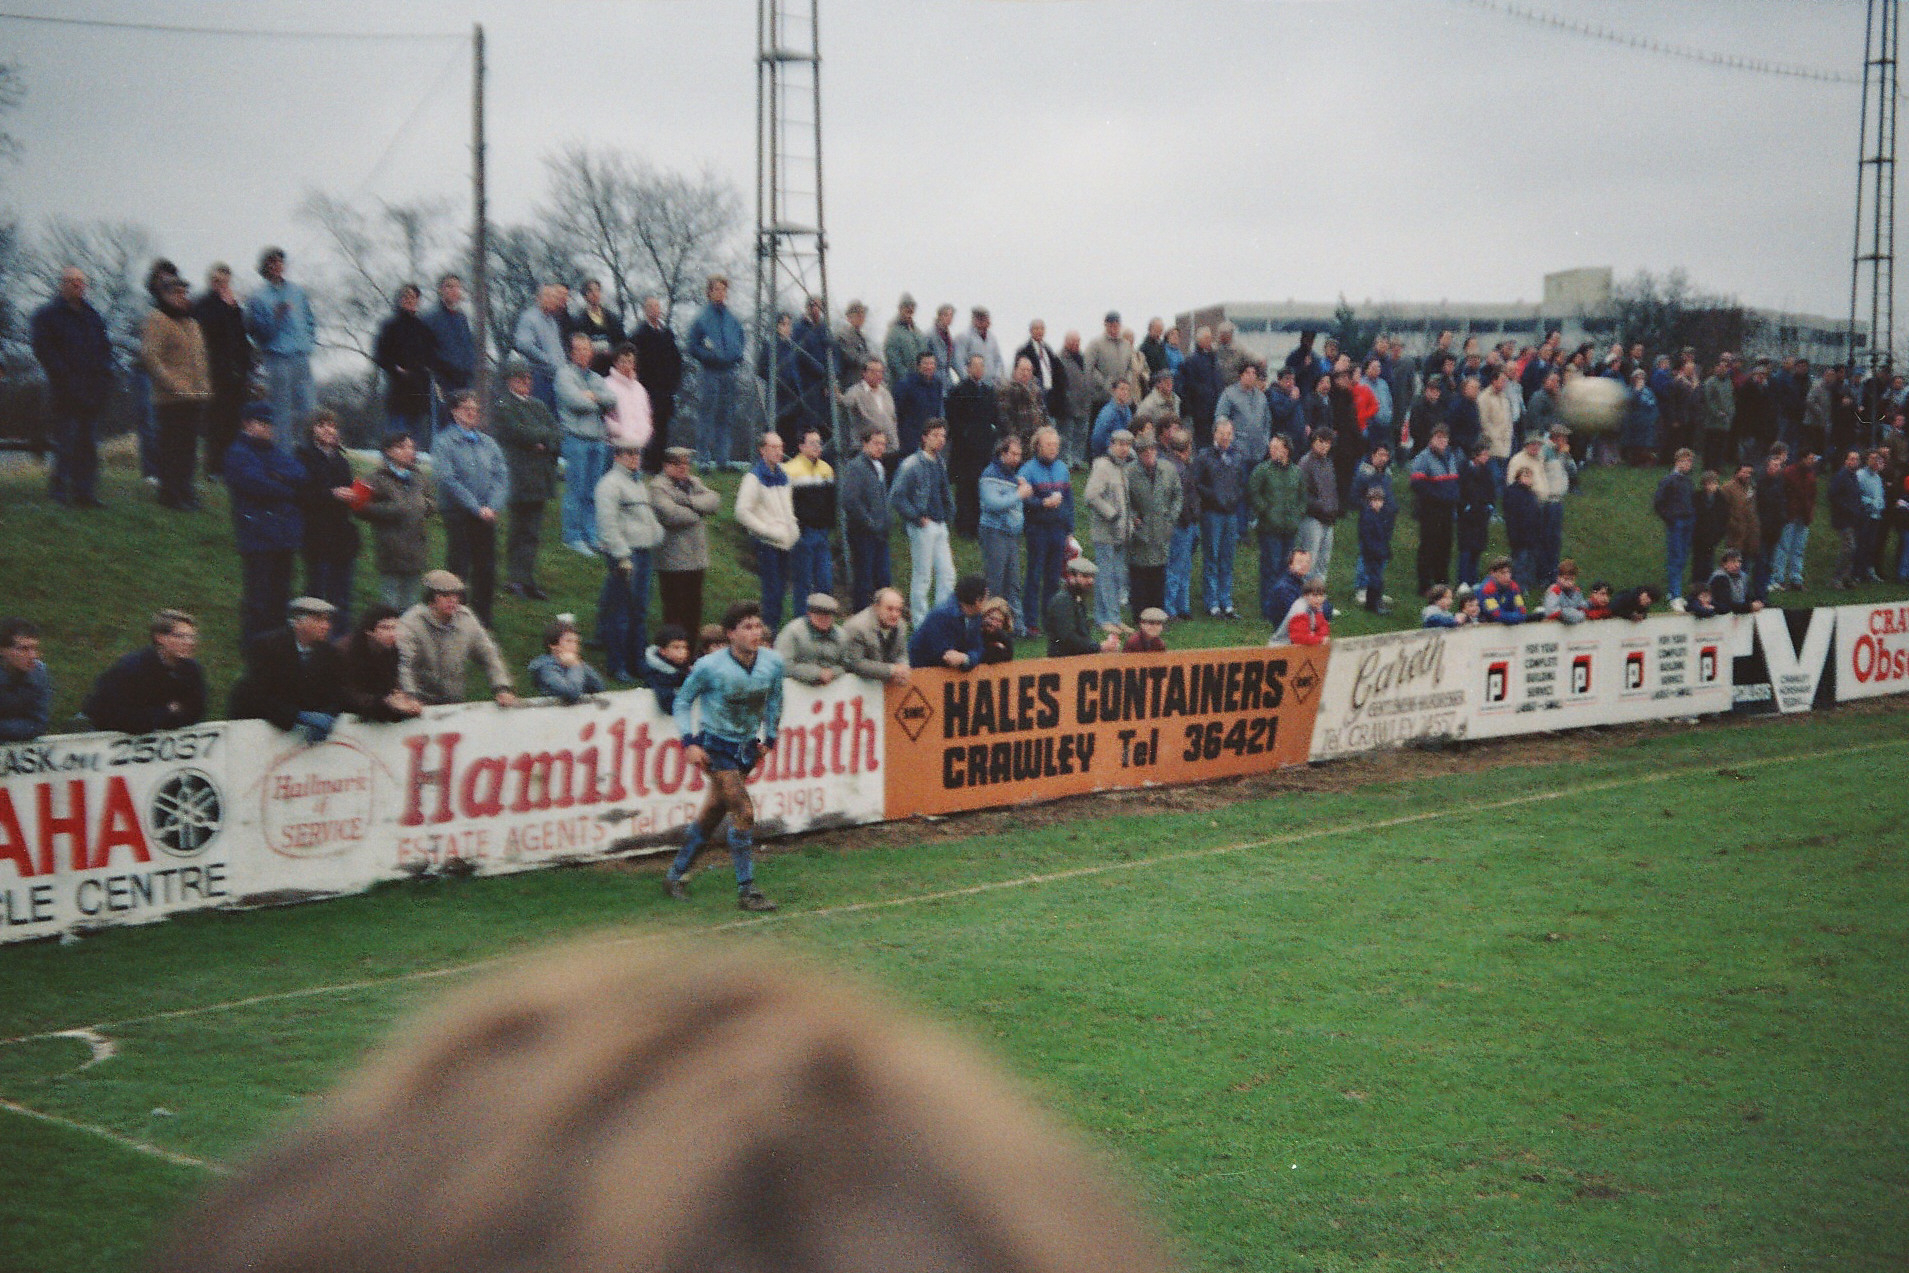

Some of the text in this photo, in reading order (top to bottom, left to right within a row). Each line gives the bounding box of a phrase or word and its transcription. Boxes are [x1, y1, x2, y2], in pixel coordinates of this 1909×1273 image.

[1869, 606, 1909, 636] CRA
[1852, 633, 1909, 684] Obs
[943, 672, 1061, 739] HALES
[1076, 659, 1288, 725] CONTAINERS
[397, 717, 706, 827] Hamilto
[942, 716, 1279, 789] CRAWLEY Tel 36421
[271, 770, 368, 801] Hallmark
[281, 816, 364, 849] SERVICE
[397, 830, 490, 866] ESTATE
[502, 815, 608, 860] AGENTS
[0, 862, 228, 927] LE CENTRE
